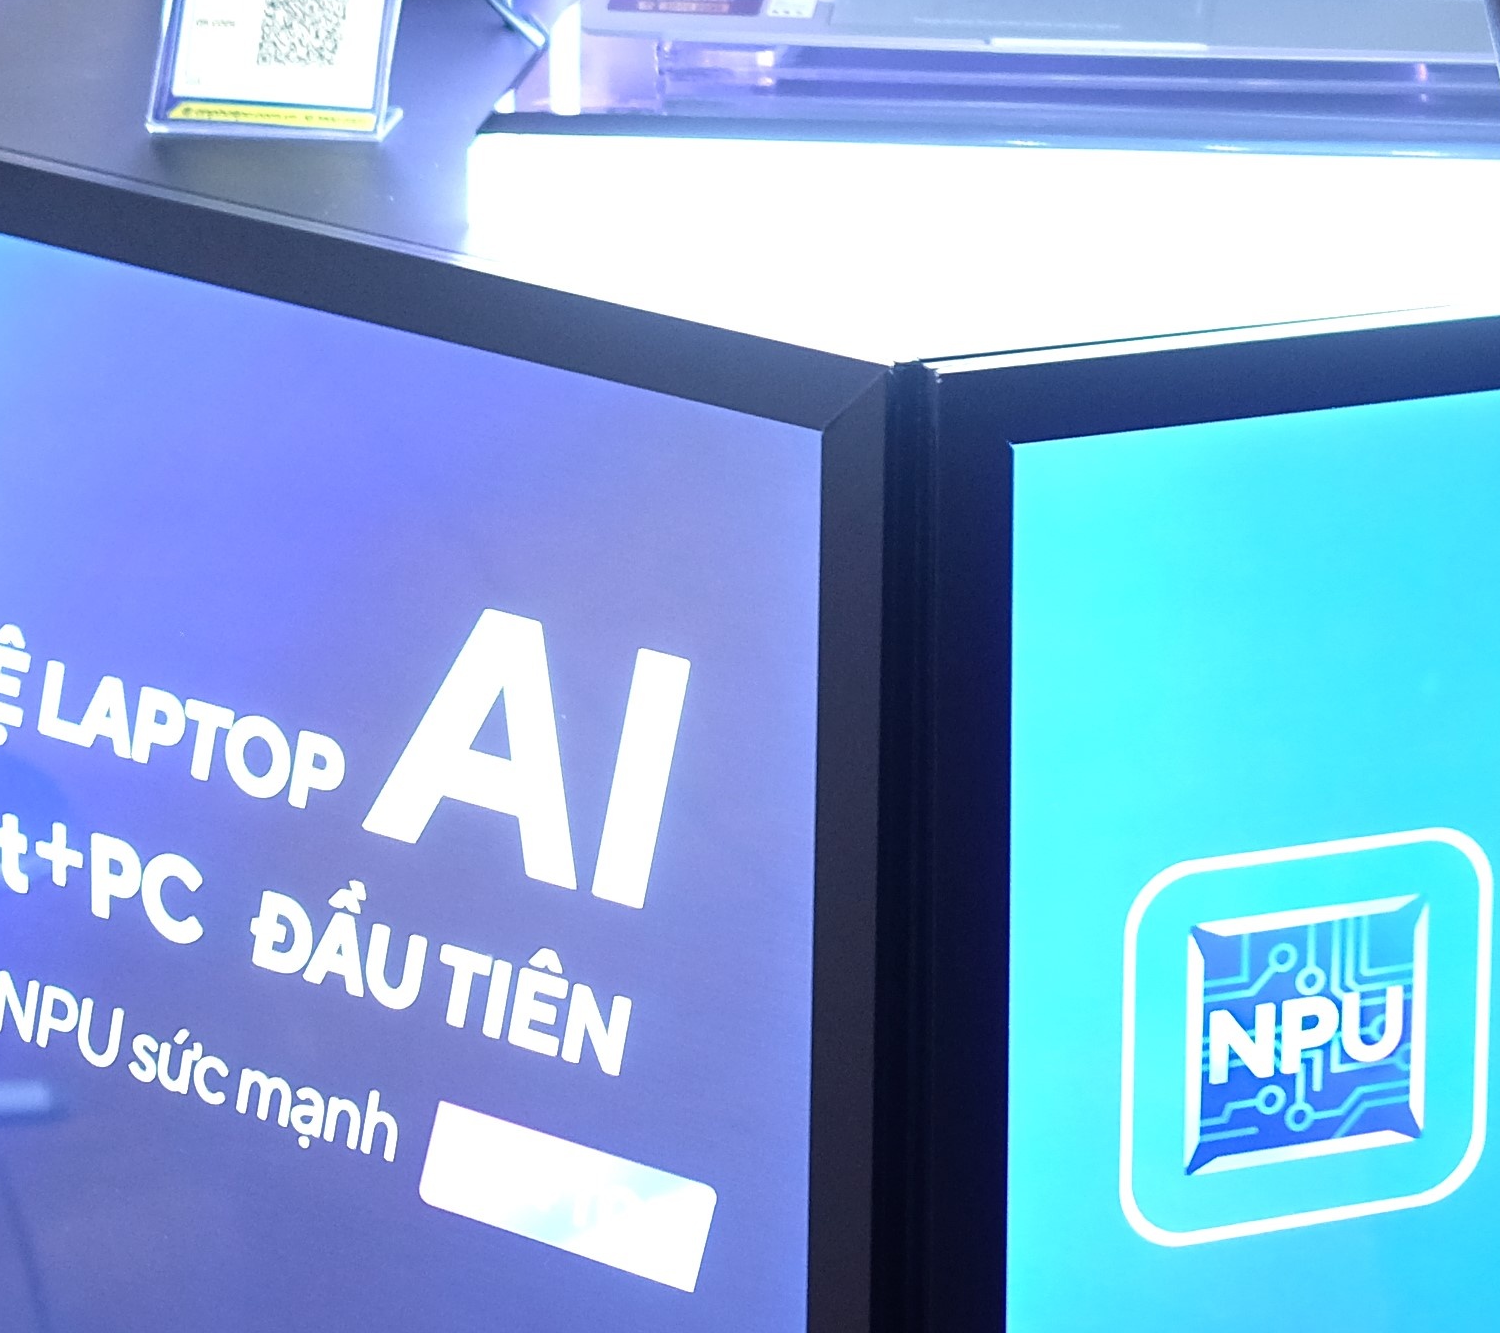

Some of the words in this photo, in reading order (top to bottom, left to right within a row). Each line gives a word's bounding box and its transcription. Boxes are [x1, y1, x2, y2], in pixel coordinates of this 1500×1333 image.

[37, 661, 346, 810] LAPTOP
[360, 607, 692, 910] AI
[248, 880, 429, 1011] ĐẦU
[439, 948, 633, 1078] TIÊN
[1208, 984, 1405, 1085] NPU
[128, 1027, 227, 1109] sức
[235, 1065, 400, 1163] mạnh
